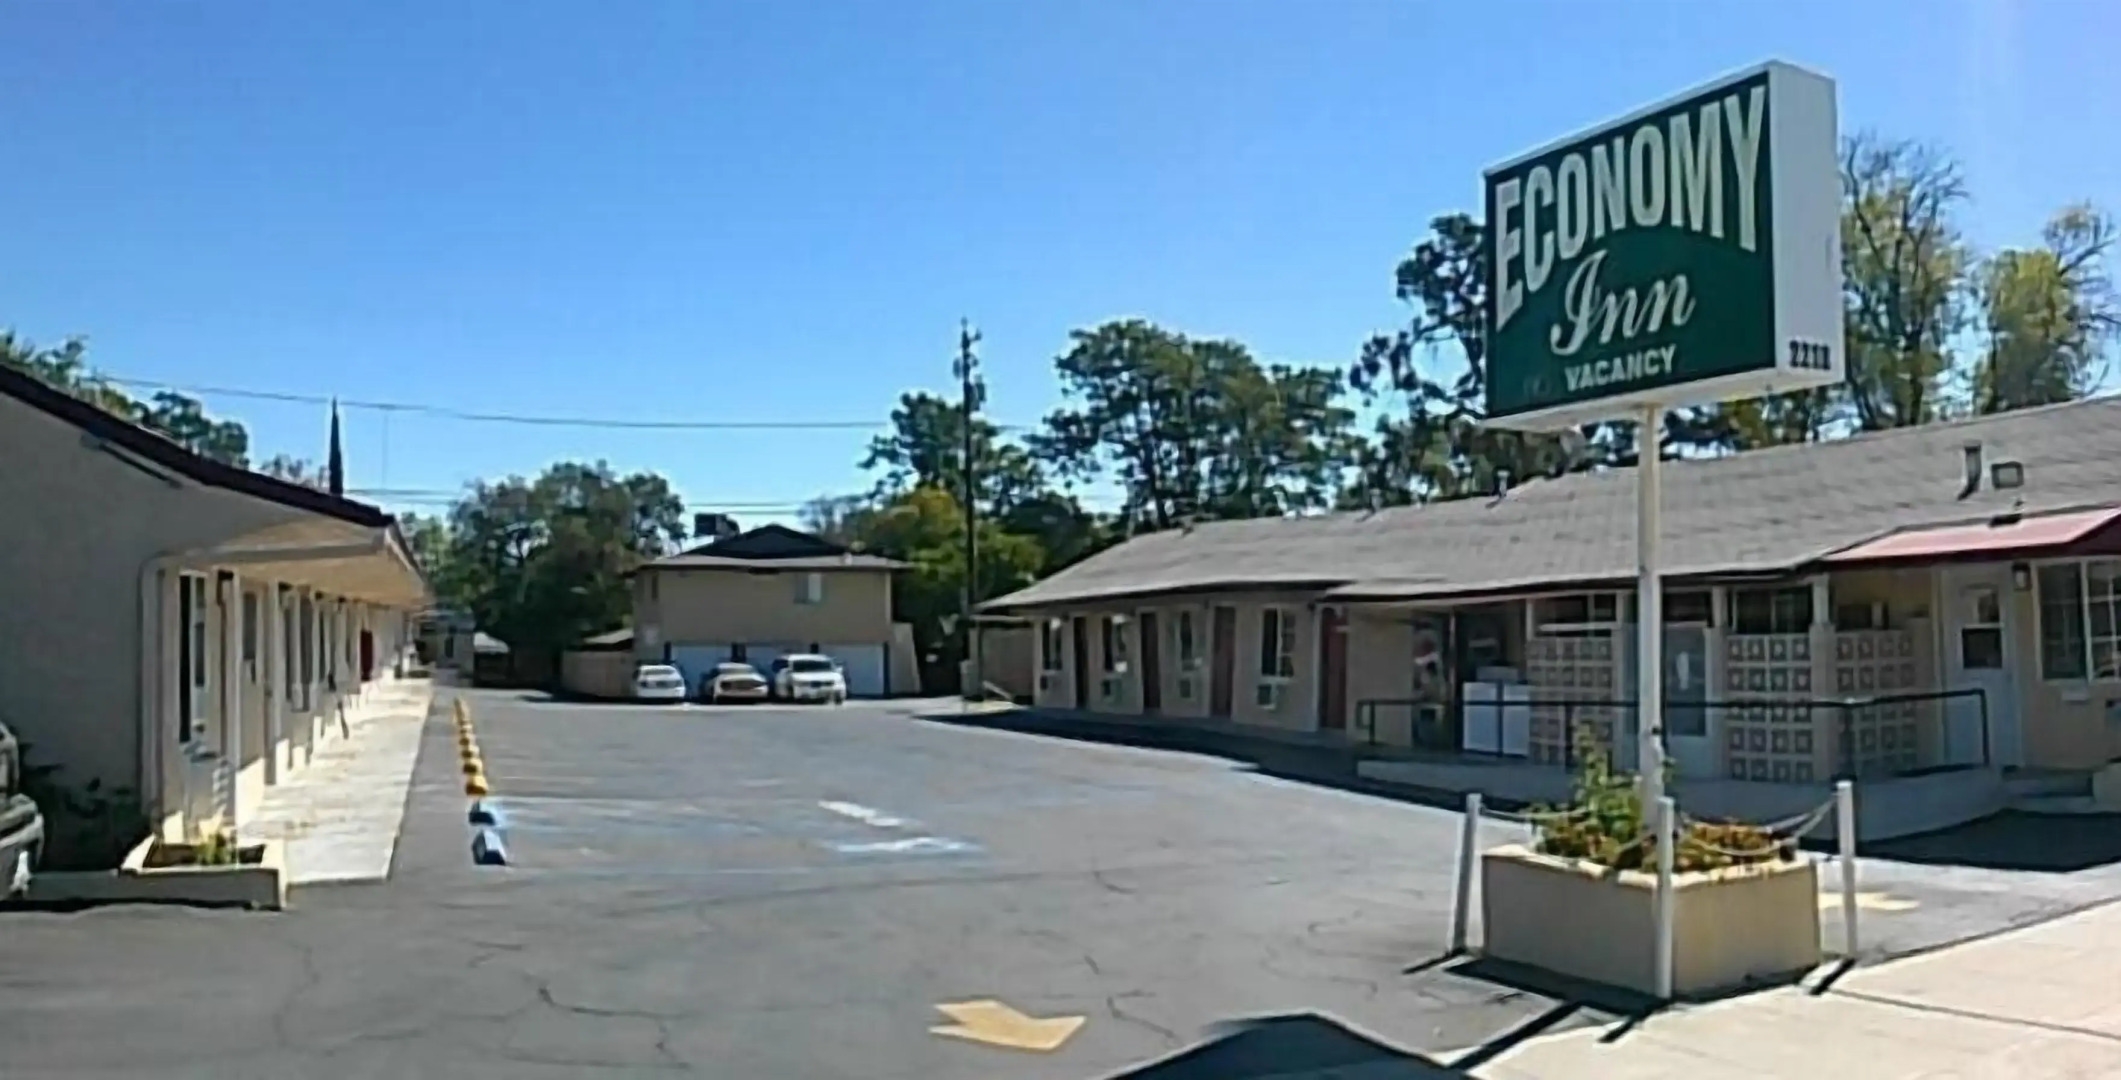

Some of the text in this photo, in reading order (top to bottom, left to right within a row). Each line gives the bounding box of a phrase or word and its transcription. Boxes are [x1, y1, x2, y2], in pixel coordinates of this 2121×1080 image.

[1495, 85, 1766, 332] ECONOMY
[1550, 249, 1697, 355] Inn
[1564, 343, 1677, 392] VACANCY
